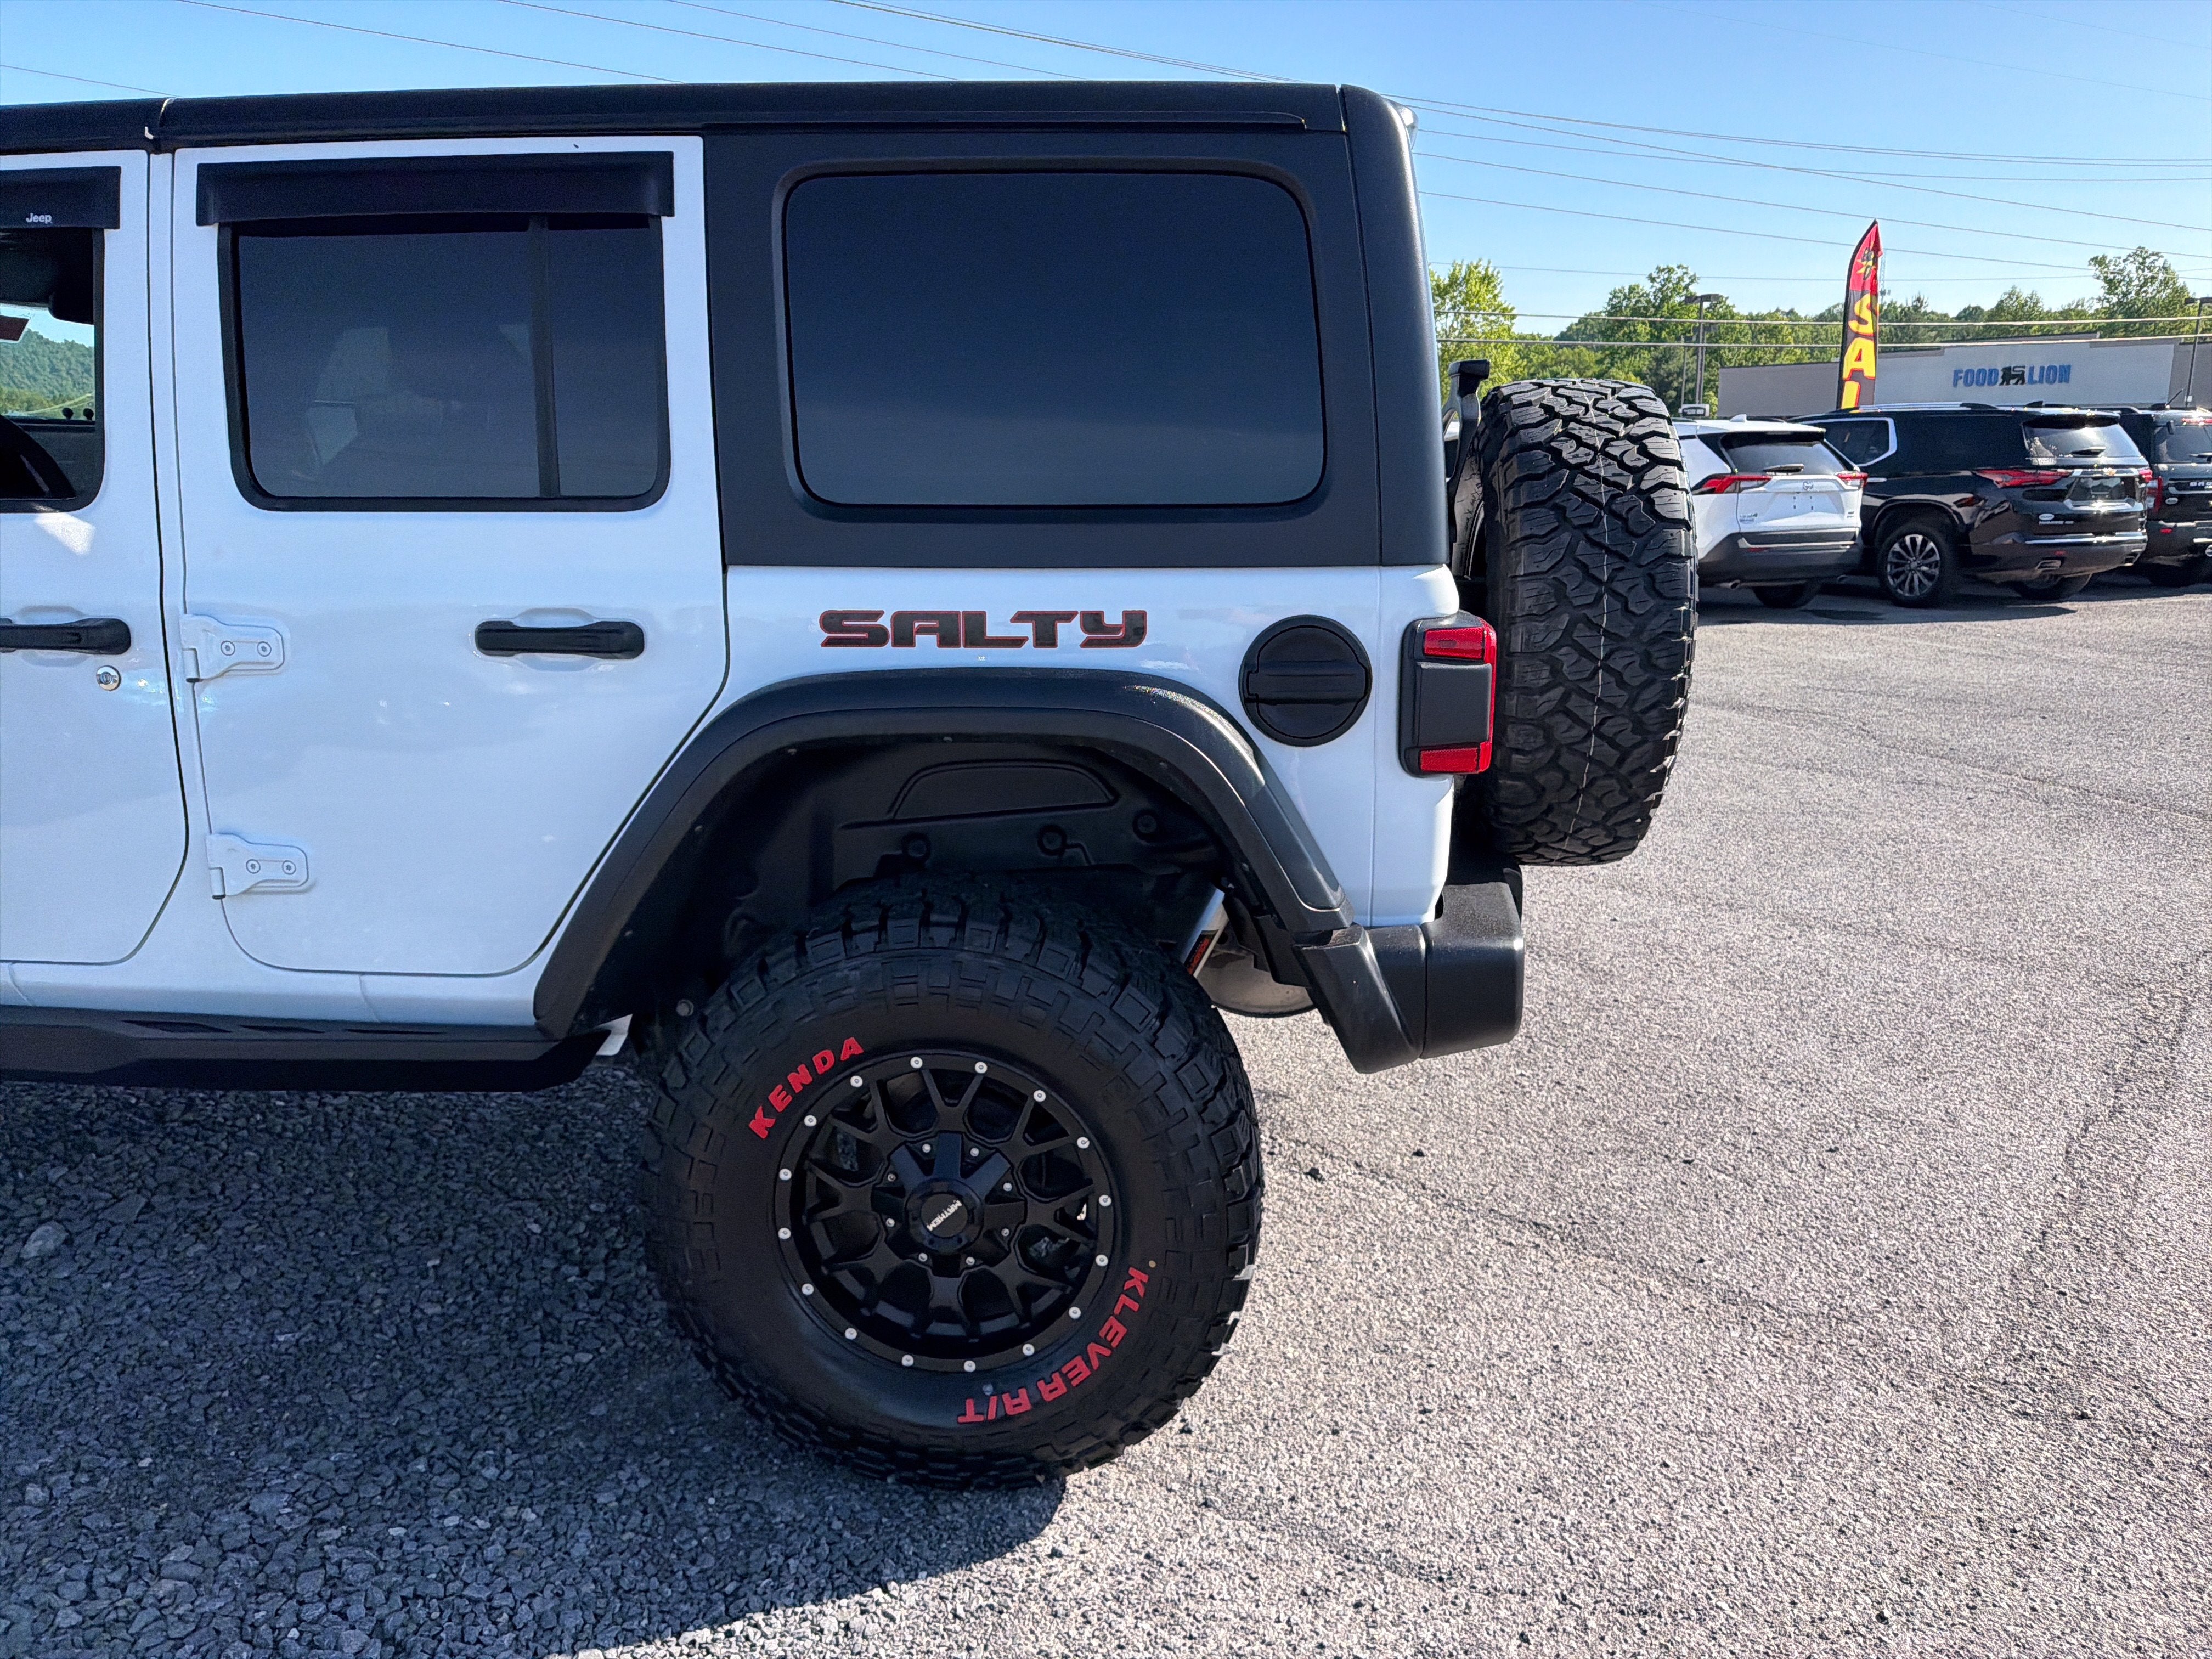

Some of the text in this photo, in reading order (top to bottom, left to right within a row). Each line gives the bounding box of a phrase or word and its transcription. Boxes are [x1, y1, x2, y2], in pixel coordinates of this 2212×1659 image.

[25, 212, 53, 224] Jeep
[1953, 364, 2072, 388] FOOD LION
[819, 610, 1148, 648] SALTY
[748, 1036, 865, 1139] KENDA
[926, 1199, 962, 1231] MAYHEM
[957, 1266, 1149, 1423] KLEVER A/T
